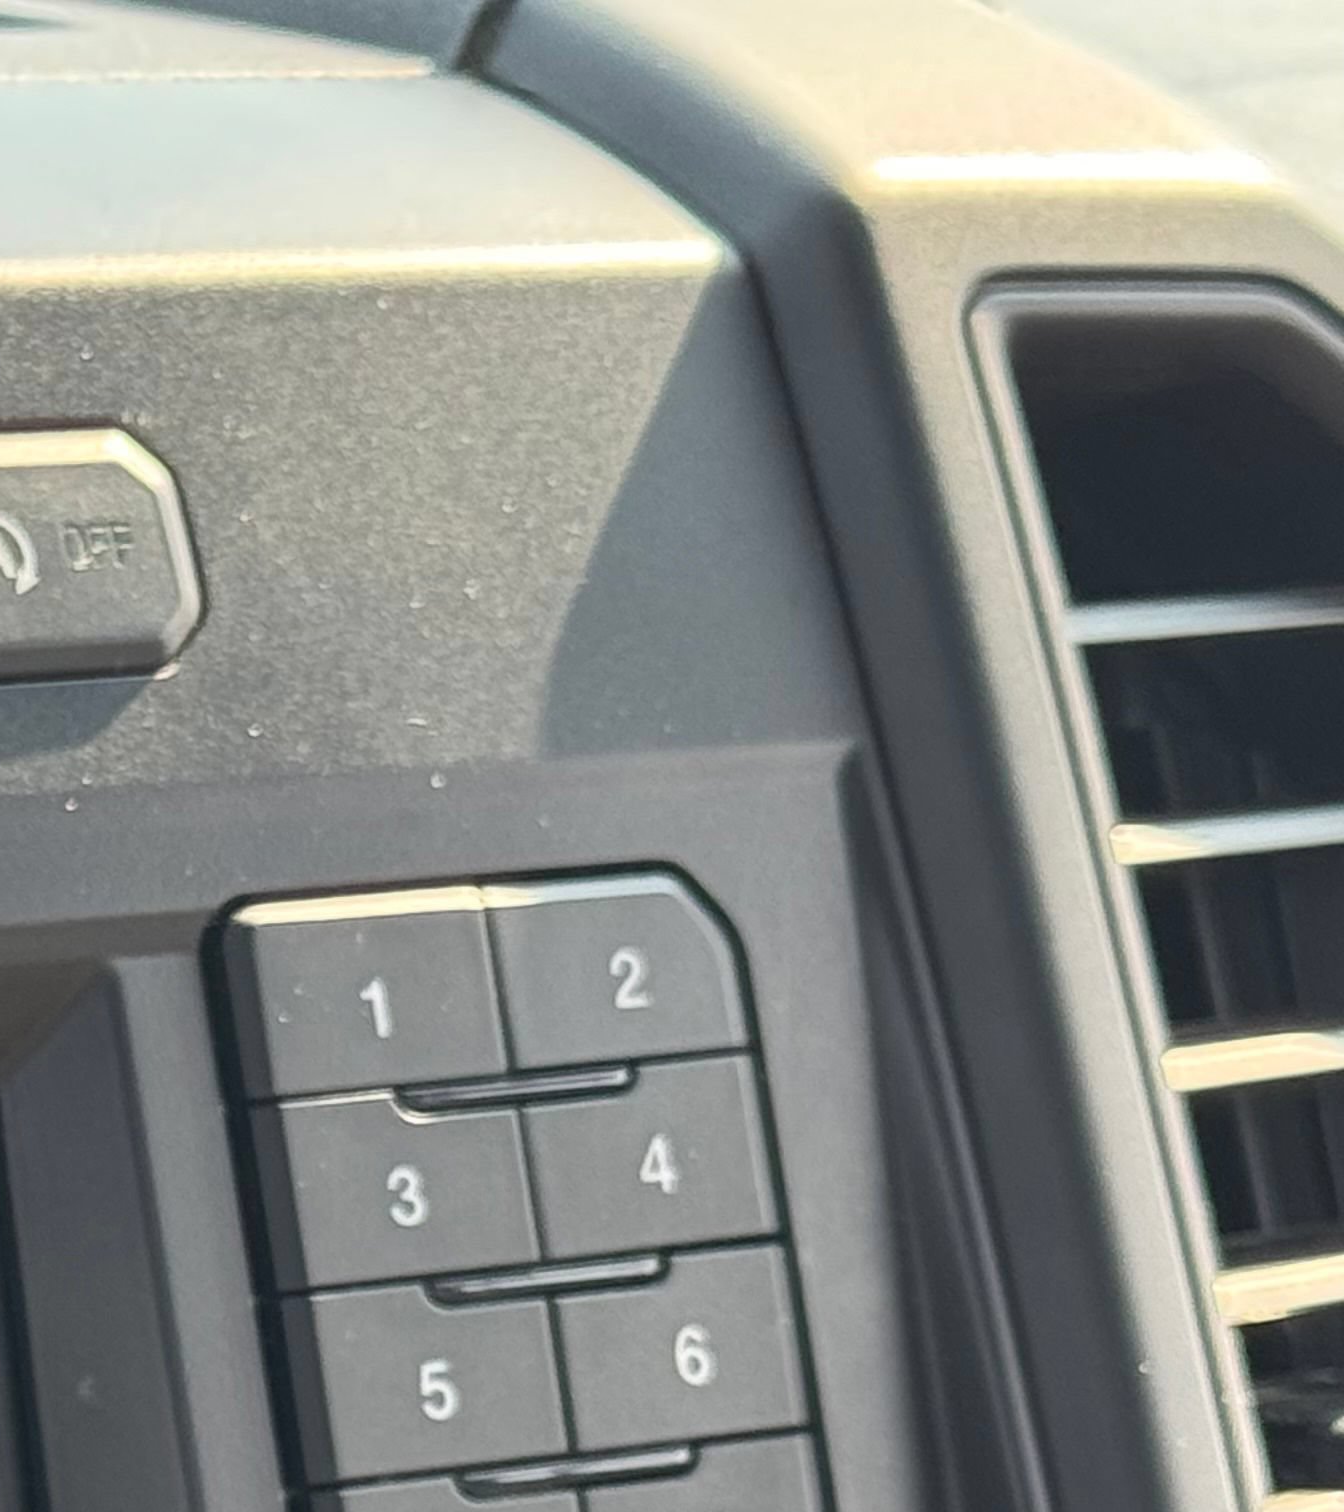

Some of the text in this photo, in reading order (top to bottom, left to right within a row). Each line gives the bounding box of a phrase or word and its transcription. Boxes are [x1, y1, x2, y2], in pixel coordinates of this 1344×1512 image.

[360, 977, 393, 1039] 1
[609, 946, 651, 1010] 2
[639, 1133, 678, 1195] 4
[386, 1165, 429, 1228] 3
[673, 1324, 715, 1386] 6
[419, 1359, 459, 1420] 5
